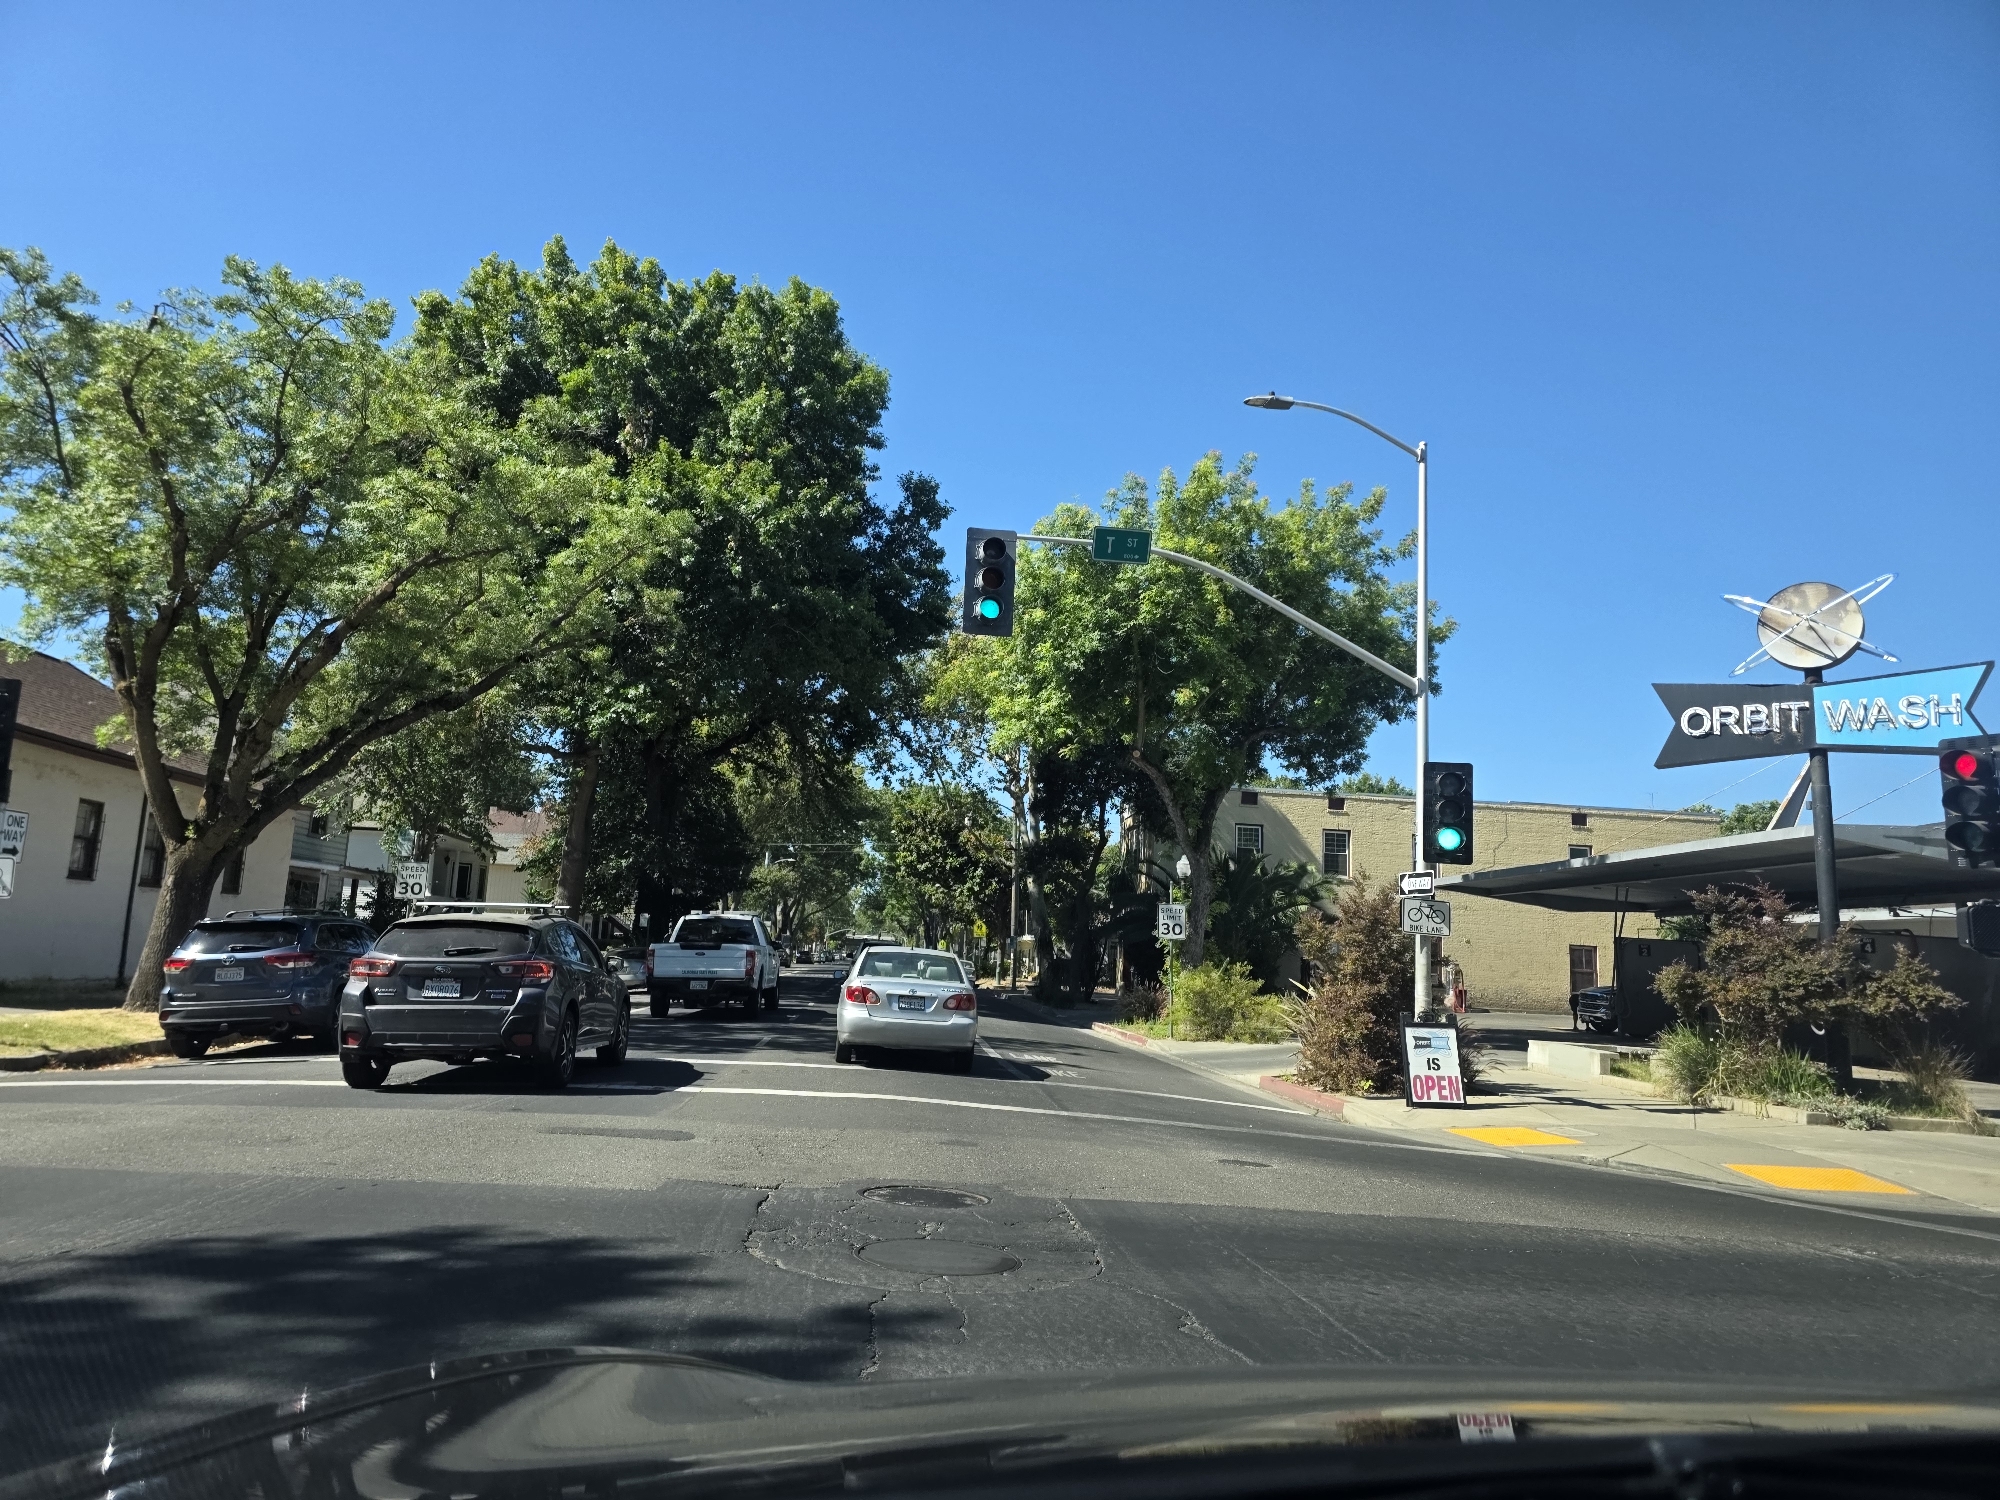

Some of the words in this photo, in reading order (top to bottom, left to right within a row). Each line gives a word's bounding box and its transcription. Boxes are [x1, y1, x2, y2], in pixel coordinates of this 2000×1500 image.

[1106, 536, 1116, 554] T
[1127, 538, 1139, 548] ST
[1680, 700, 1810, 738] ORBIT
[1821, 693, 1963, 733] WASH
[7, 814, 26, 829] ONE
[3, 829, 25, 843] WAY
[400, 865, 426, 873] SPEED
[398, 881, 423, 896] 30
[1407, 879, 1417, 889] ONE
[1418, 878, 1430, 888] WAY
[1160, 907, 1184, 915] SPEED
[1160, 922, 1183, 936] 30
[1409, 924, 1424, 933] BIKE
[1424, 926, 1445, 935] LANE
[1641, 948, 1649, 957] 2
[1864, 943, 1873, 953] 4
[1008, 1052, 1064, 1064] LANE
[1426, 1057, 1442, 1072] IS
[1412, 1074, 1462, 1102] OPEN
